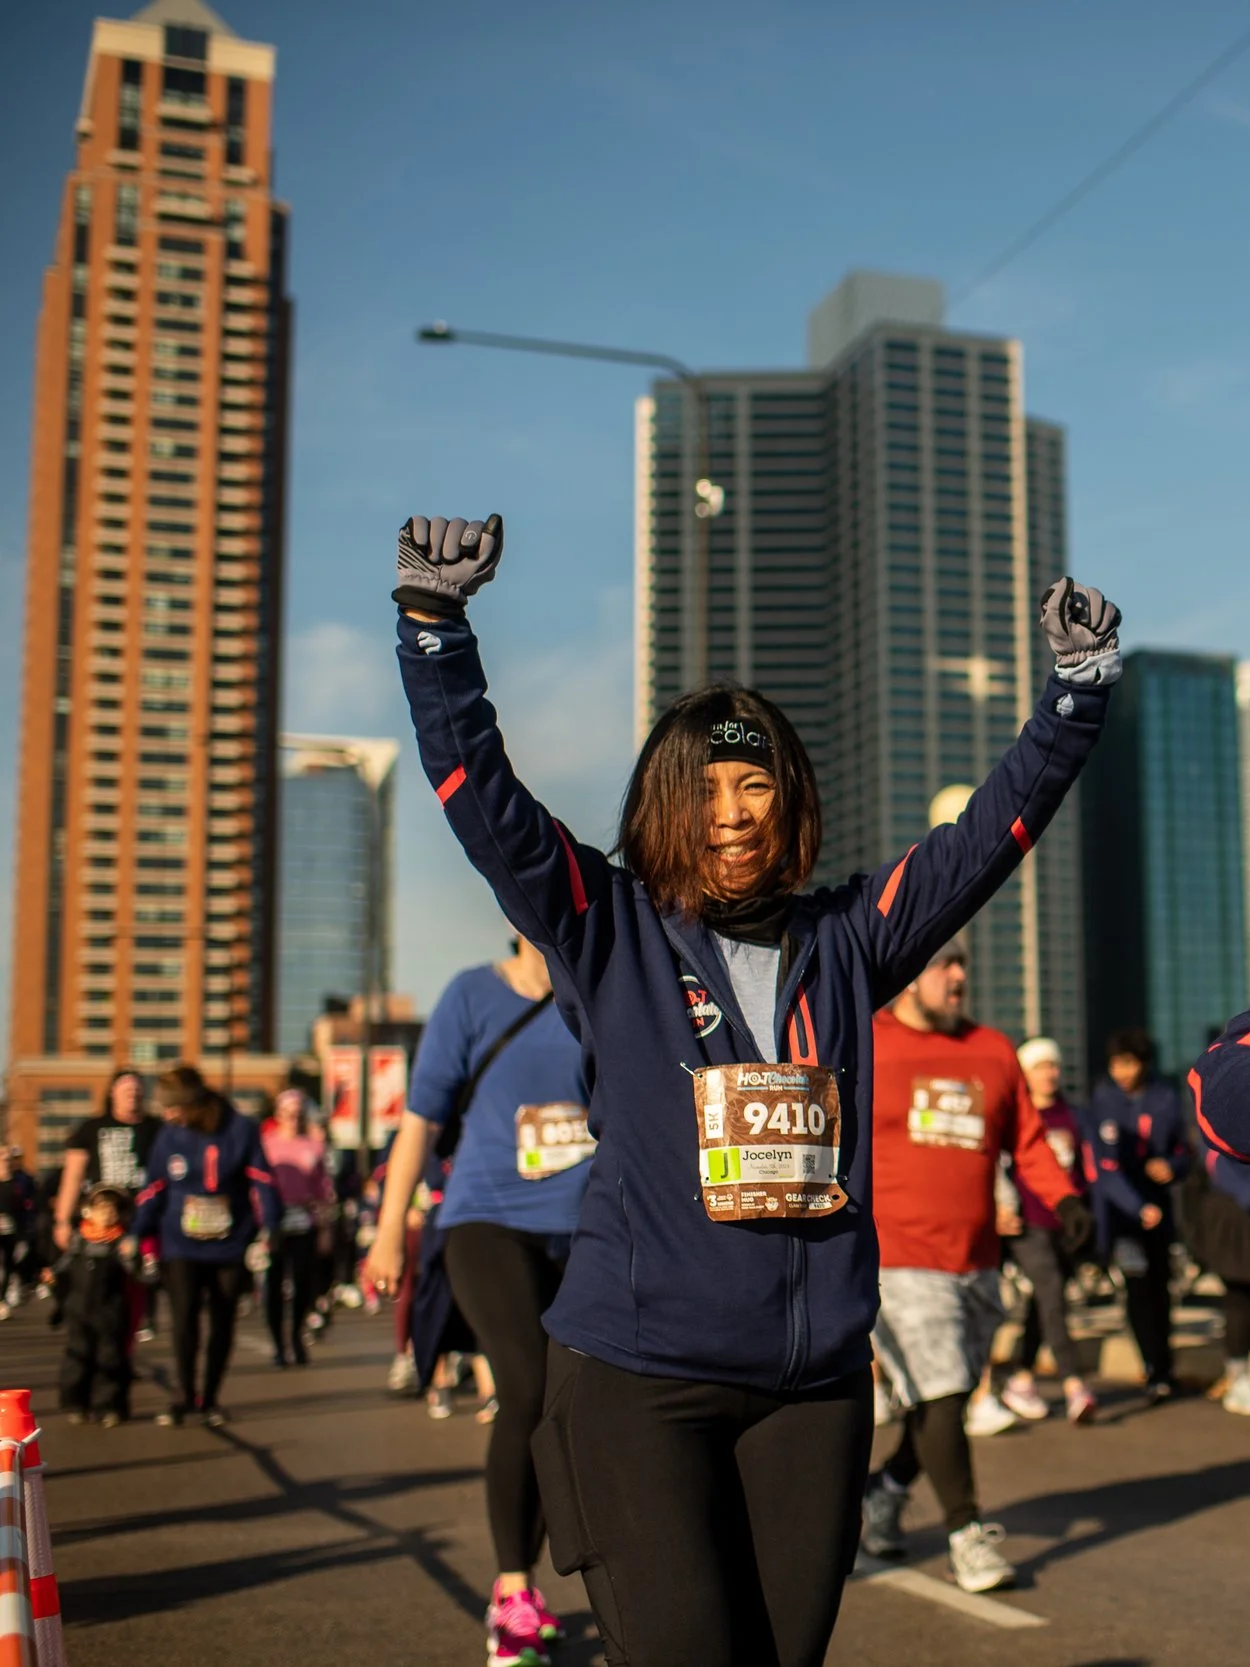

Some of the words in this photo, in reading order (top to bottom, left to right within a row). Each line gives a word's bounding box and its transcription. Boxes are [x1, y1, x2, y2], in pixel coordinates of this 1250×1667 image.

[737, 1071, 770, 1086] HOT
[709, 1112, 719, 1131] 5K
[743, 1102, 825, 1136] 9410
[742, 1149, 793, 1162] Jocelyn
[720, 1152, 729, 1179] J
[785, 1193, 806, 1203] GEAR
[807, 1193, 832, 1203] CHECK
